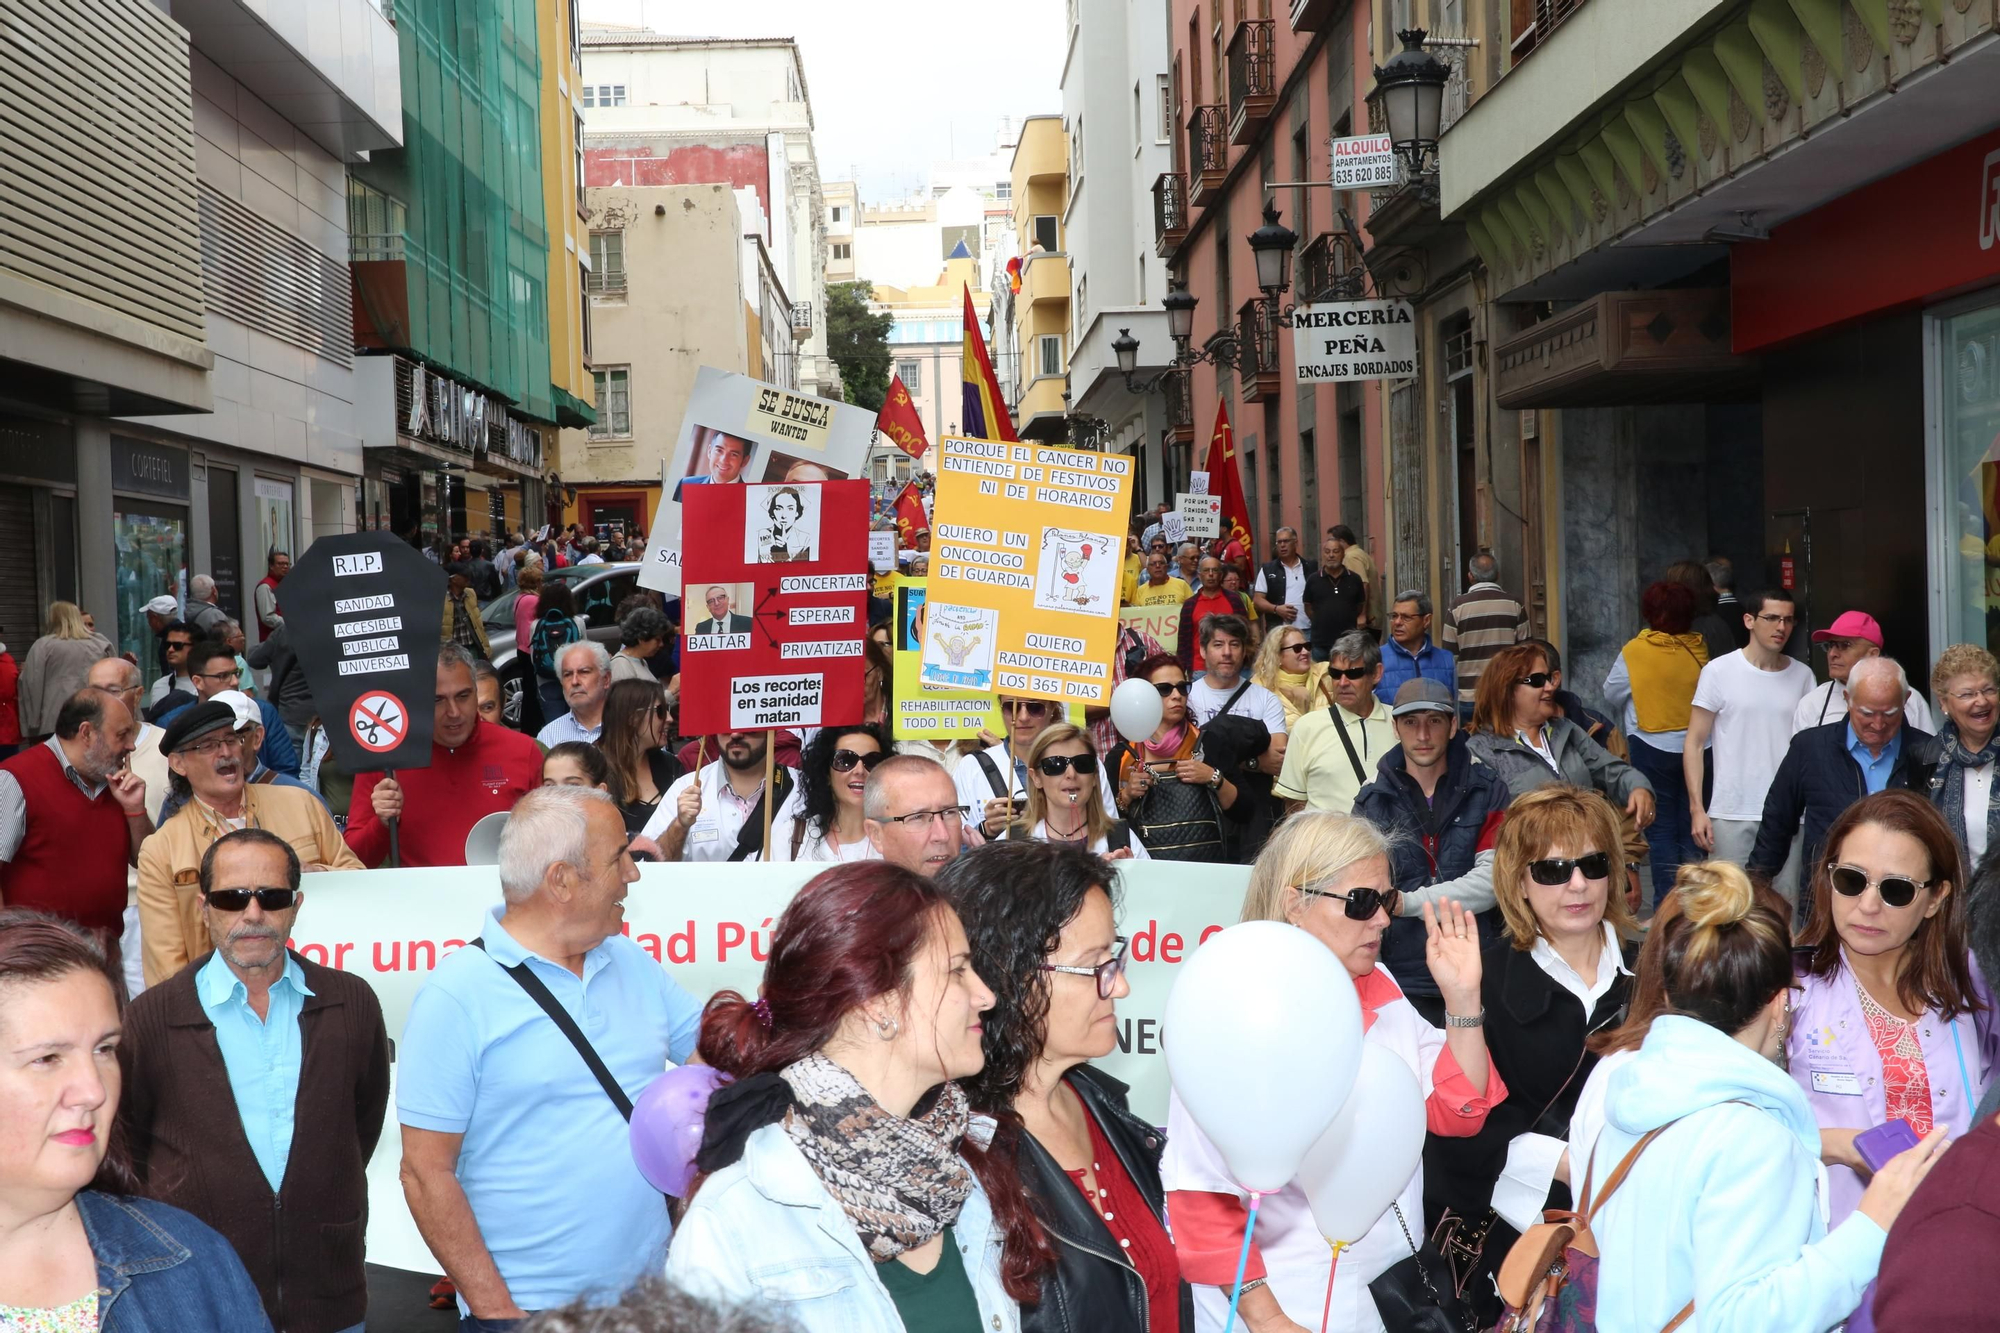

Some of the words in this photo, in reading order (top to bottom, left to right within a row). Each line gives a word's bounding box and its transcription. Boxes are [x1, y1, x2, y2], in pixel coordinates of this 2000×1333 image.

[1335, 138, 1391, 156] ALQUILO
[1335, 154, 1391, 167] APARTAMENTOS
[1335, 169, 1353, 184] 635
[1355, 168, 1373, 182] 620
[1375, 165, 1391, 180] 885
[1295, 305, 1411, 329] MERCERÍA
[1324, 334, 1386, 355] PEÑA
[1299, 363, 1348, 379] ENCAJES
[1353, 360, 1413, 376] BORDADOS
[758, 388, 780, 413] SE
[781, 396, 830, 427] BUSCA
[770, 420, 808, 442] WANTED
[888, 421, 922, 454] PCPC
[945, 439, 1005, 459] PORQUE
[1014, 448, 1030, 461] EL
[1037, 450, 1094, 469] CANCER
[1103, 460, 1126, 474] NO
[131, 453, 172, 483] CORTEFIEL
[943, 457, 1013, 477] ENTIENDE
[1023, 468, 1042, 481] DE
[1051, 470, 1116, 491] FESTIVOS
[981, 481, 996, 494] NI
[1007, 485, 1026, 499] DE
[1037, 488, 1112, 509] HORARIOS
[938, 524, 993, 543] QUIERO
[1005, 533, 1026, 547] UN
[335, 555, 381, 574] R.I.P.
[941, 546, 1023, 568] ONCOLOGO
[781, 576, 865, 591] CONCERTAR
[940, 565, 958, 578] DE
[966, 568, 1031, 589] GUARDIA
[335, 595, 392, 613] SANIDAD
[790, 608, 850, 623] ESPERAR
[336, 617, 400, 637] ACCESIBLE
[343, 638, 396, 654] PUBLICA
[689, 634, 746, 650] BALTAR
[782, 642, 862, 657] PRIVATIZAR
[1026, 634, 1082, 653] QUIERO
[339, 655, 408, 674] UNIVERSAL
[999, 652, 1103, 677] RADIOTERAPIA
[733, 680, 760, 694] Los
[765, 677, 821, 693] recortes
[1000, 674, 1026, 688] LOS
[1033, 678, 1058, 692] 365
[1066, 683, 1098, 699] DIAS
[737, 698, 756, 709] en
[760, 692, 819, 707] sanidad
[901, 700, 991, 711] REHABILITACION
[755, 710, 801, 724] matan
[905, 717, 936, 728] TODO
[945, 717, 956, 728] EL
[963, 717, 982, 728] DIA
[285, 937, 354, 972] or
[717, 918, 777, 963] Pú
[1131, 919, 1184, 964] de
[1115, 1018, 1165, 1055] NE
